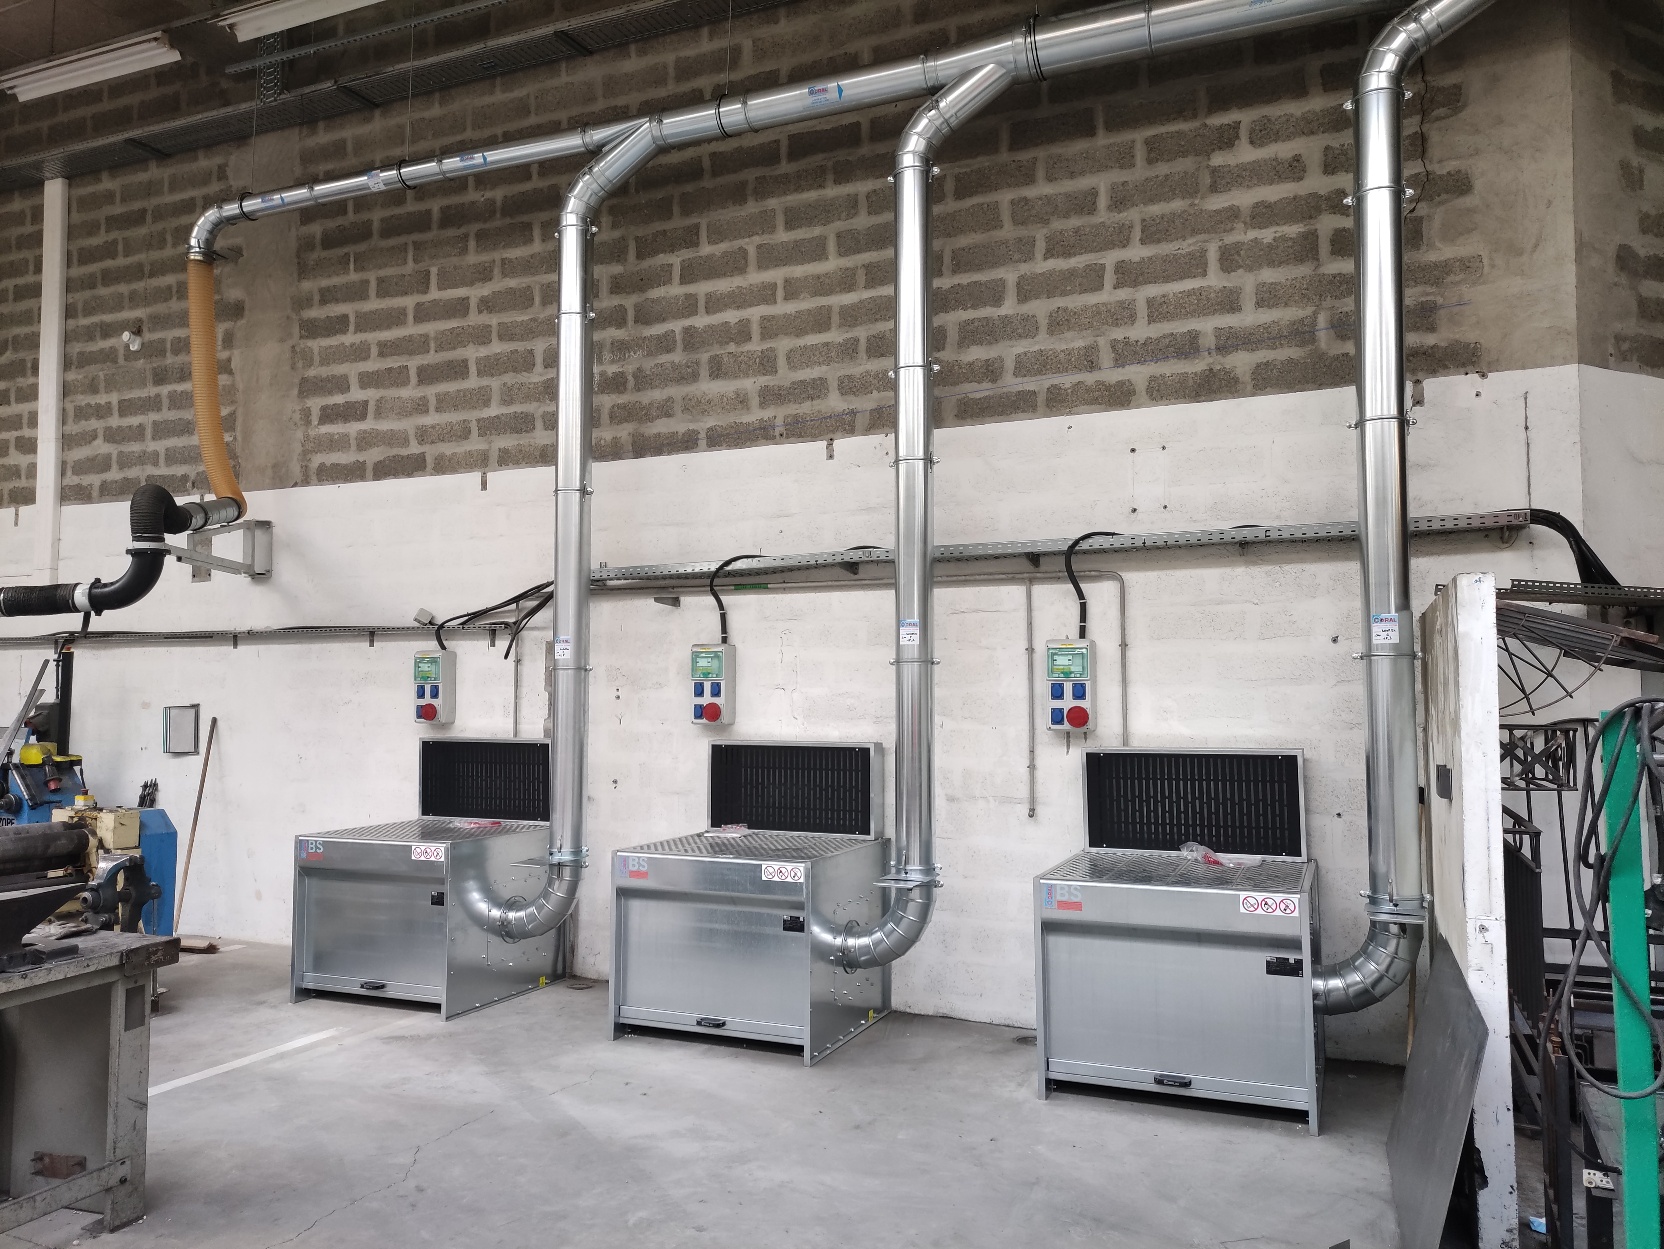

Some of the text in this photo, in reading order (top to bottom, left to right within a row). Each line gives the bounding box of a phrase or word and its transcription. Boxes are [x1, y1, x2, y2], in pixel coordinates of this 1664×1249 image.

[308, 840, 323, 853] BS
[629, 856, 648, 871] BS
[1056, 884, 1082, 901] BS
